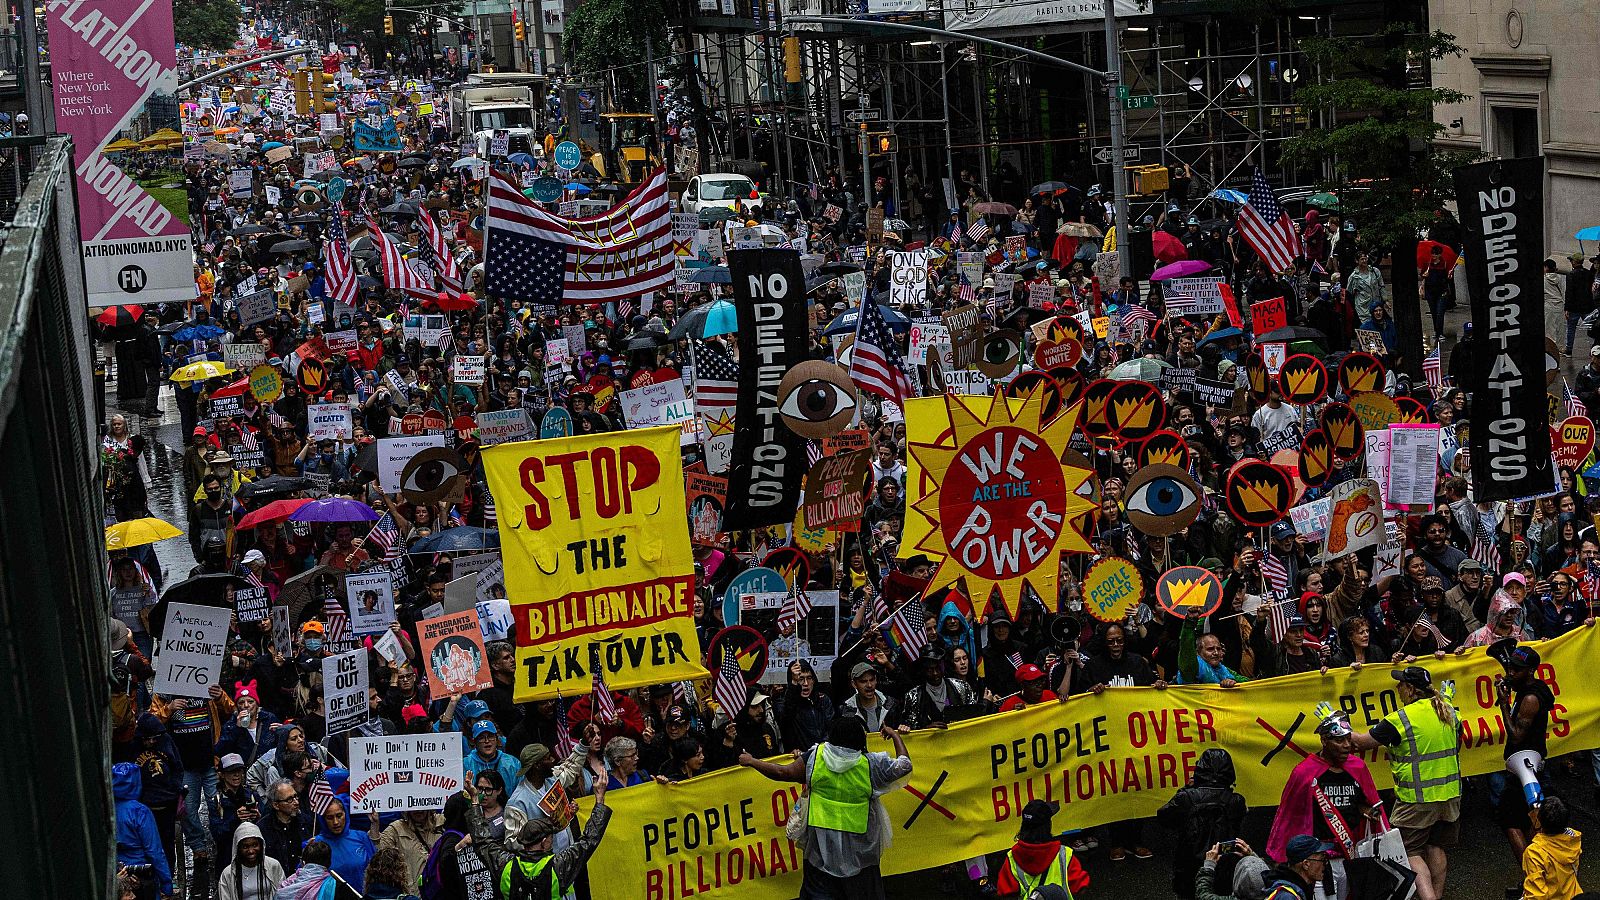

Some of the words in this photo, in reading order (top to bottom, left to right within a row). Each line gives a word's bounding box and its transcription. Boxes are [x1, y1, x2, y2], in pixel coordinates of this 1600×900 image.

[58, 71, 94, 82] Where
[59, 84, 83, 94] New
[86, 81, 111, 92] York
[60, 95, 92, 105] meets
[1134, 97, 1141, 107] 31
[61, 107, 85, 117] New
[87, 104, 112, 115] York
[558, 146, 577, 154] PEACE
[76, 154, 172, 236] NOMAD
[1478, 186, 1515, 211] NO
[568, 203, 638, 247] NO
[574, 236, 662, 283] KINGS
[892, 252, 929, 268] ONLY
[121, 269, 143, 288] FN
[892, 267, 927, 285] GOD
[748, 273, 788, 299] NO
[1183, 282, 1212, 291] PROTECT
[892, 288, 926, 304] KING
[1253, 301, 1283, 319] MAGA
[947, 308, 980, 331] FREEDOM
[1263, 318, 1276, 328] IS
[1043, 343, 1072, 356] WORKERS
[1481, 213, 1528, 481] DEPORTATIONS
[1045, 351, 1071, 366] UNITE
[253, 373, 276, 388] PEOPLE
[631, 370, 652, 388] HANDS
[1165, 368, 1196, 377] DICTATORS
[255, 383, 278, 397] POWER
[642, 384, 667, 396] Giving
[1220, 388, 1235, 397] NOT
[225, 403, 239, 411] LORD
[748, 302, 787, 507] DETENTIONS
[1209, 394, 1226, 404] KING
[313, 414, 345, 423] GREATER
[665, 401, 693, 421] ALL
[426, 420, 445, 429] OUR
[1262, 430, 1283, 450] RISE
[1283, 426, 1294, 438] UP
[1564, 426, 1588, 441] OUR
[244, 450, 265, 459] DANGER
[711, 441, 725, 453] NO
[250, 459, 261, 467] ALL
[960, 431, 1039, 484] WE
[819, 452, 861, 481] PEOPLE
[519, 445, 661, 531] STOP
[691, 484, 701, 492] ARE
[701, 485, 712, 493] NEW
[693, 477, 726, 489] IMMIGRANTS
[823, 480, 843, 498] OVER
[972, 485, 1001, 503] ARE
[1004, 481, 1032, 498] THE
[1291, 507, 1310, 523] NO
[950, 499, 1062, 575] POWER
[566, 534, 627, 575] THE
[391, 558, 403, 570] UP
[348, 579, 365, 587] FREE
[365, 578, 388, 586] DYLAN!
[731, 575, 768, 603] PEACE
[1090, 565, 1131, 604] PEOPLE
[236, 589, 254, 601] RISE
[254, 587, 265, 597] UP
[1098, 581, 1135, 613] POWER
[236, 597, 268, 611] AGAINST
[763, 598, 776, 607] NO
[238, 607, 270, 622] CRUELTY
[528, 582, 688, 641] BILLIONAIRE
[424, 615, 471, 632] IMMIGRANTS
[424, 632, 438, 640] ARE
[439, 628, 454, 637] NEW
[456, 621, 477, 633] YORK!
[182, 628, 205, 641] NO
[165, 640, 194, 653] KING
[195, 642, 224, 656] SINCE
[340, 642, 353, 652] ALL
[337, 655, 357, 673] ICE
[522, 631, 691, 688] TAKEOVER
[167, 664, 209, 685] 1776
[335, 670, 358, 689] OUT
[330, 697, 344, 711] OF
[346, 690, 365, 704] OUR
[328, 702, 367, 720] COMMUNITIES!
[365, 742, 379, 754] WE
[386, 741, 409, 753] DON'T
[416, 740, 436, 752] NEED
[441, 743, 446, 751] A
[990, 715, 1110, 780] PEOPLE
[1127, 708, 1218, 749] OVER
[364, 758, 382, 771] KING
[388, 757, 409, 770] FROM
[415, 757, 445, 769] QUEENS
[350, 771, 389, 804] IMPEACH
[419, 771, 457, 791] TRUMP
[1323, 784, 1356, 796] ABOLISH
[362, 798, 381, 810] SAVE
[388, 797, 403, 809] OUR
[1315, 788, 1331, 812] VOTE
[642, 797, 757, 863] PEOPLE
[1329, 814, 1351, 847] RESIST
[459, 863, 470, 874] NO
